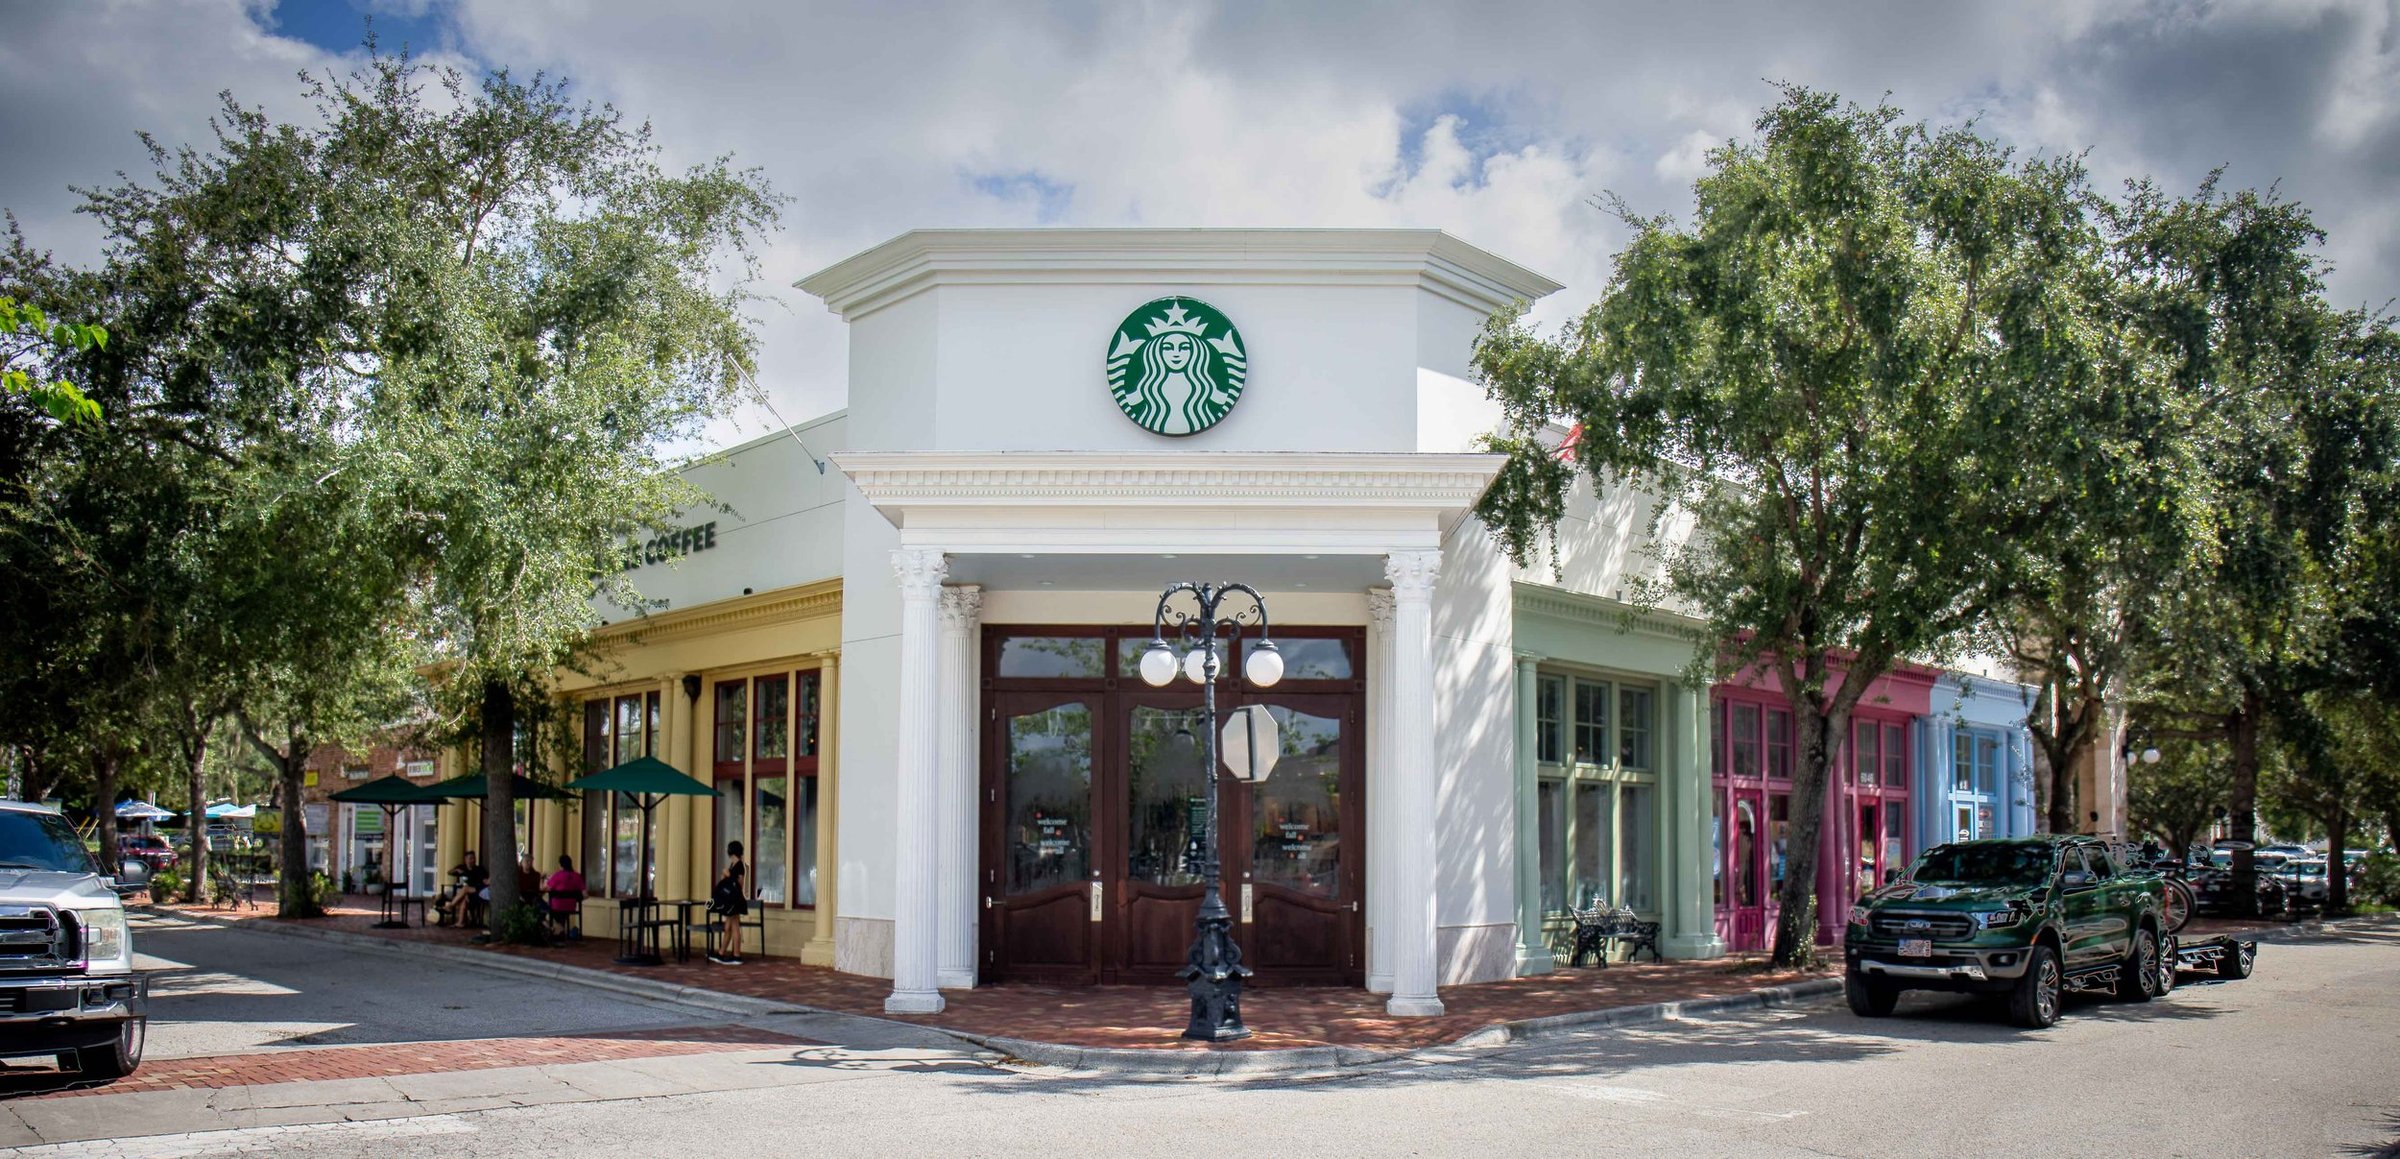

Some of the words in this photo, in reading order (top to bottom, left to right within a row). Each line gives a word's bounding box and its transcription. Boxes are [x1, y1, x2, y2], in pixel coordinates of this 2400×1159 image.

[645, 521, 716, 566] COFFEE
[1037, 818, 1068, 826] welcome
[1043, 826, 1055, 834] fall
[1285, 831, 1297, 839] fall
